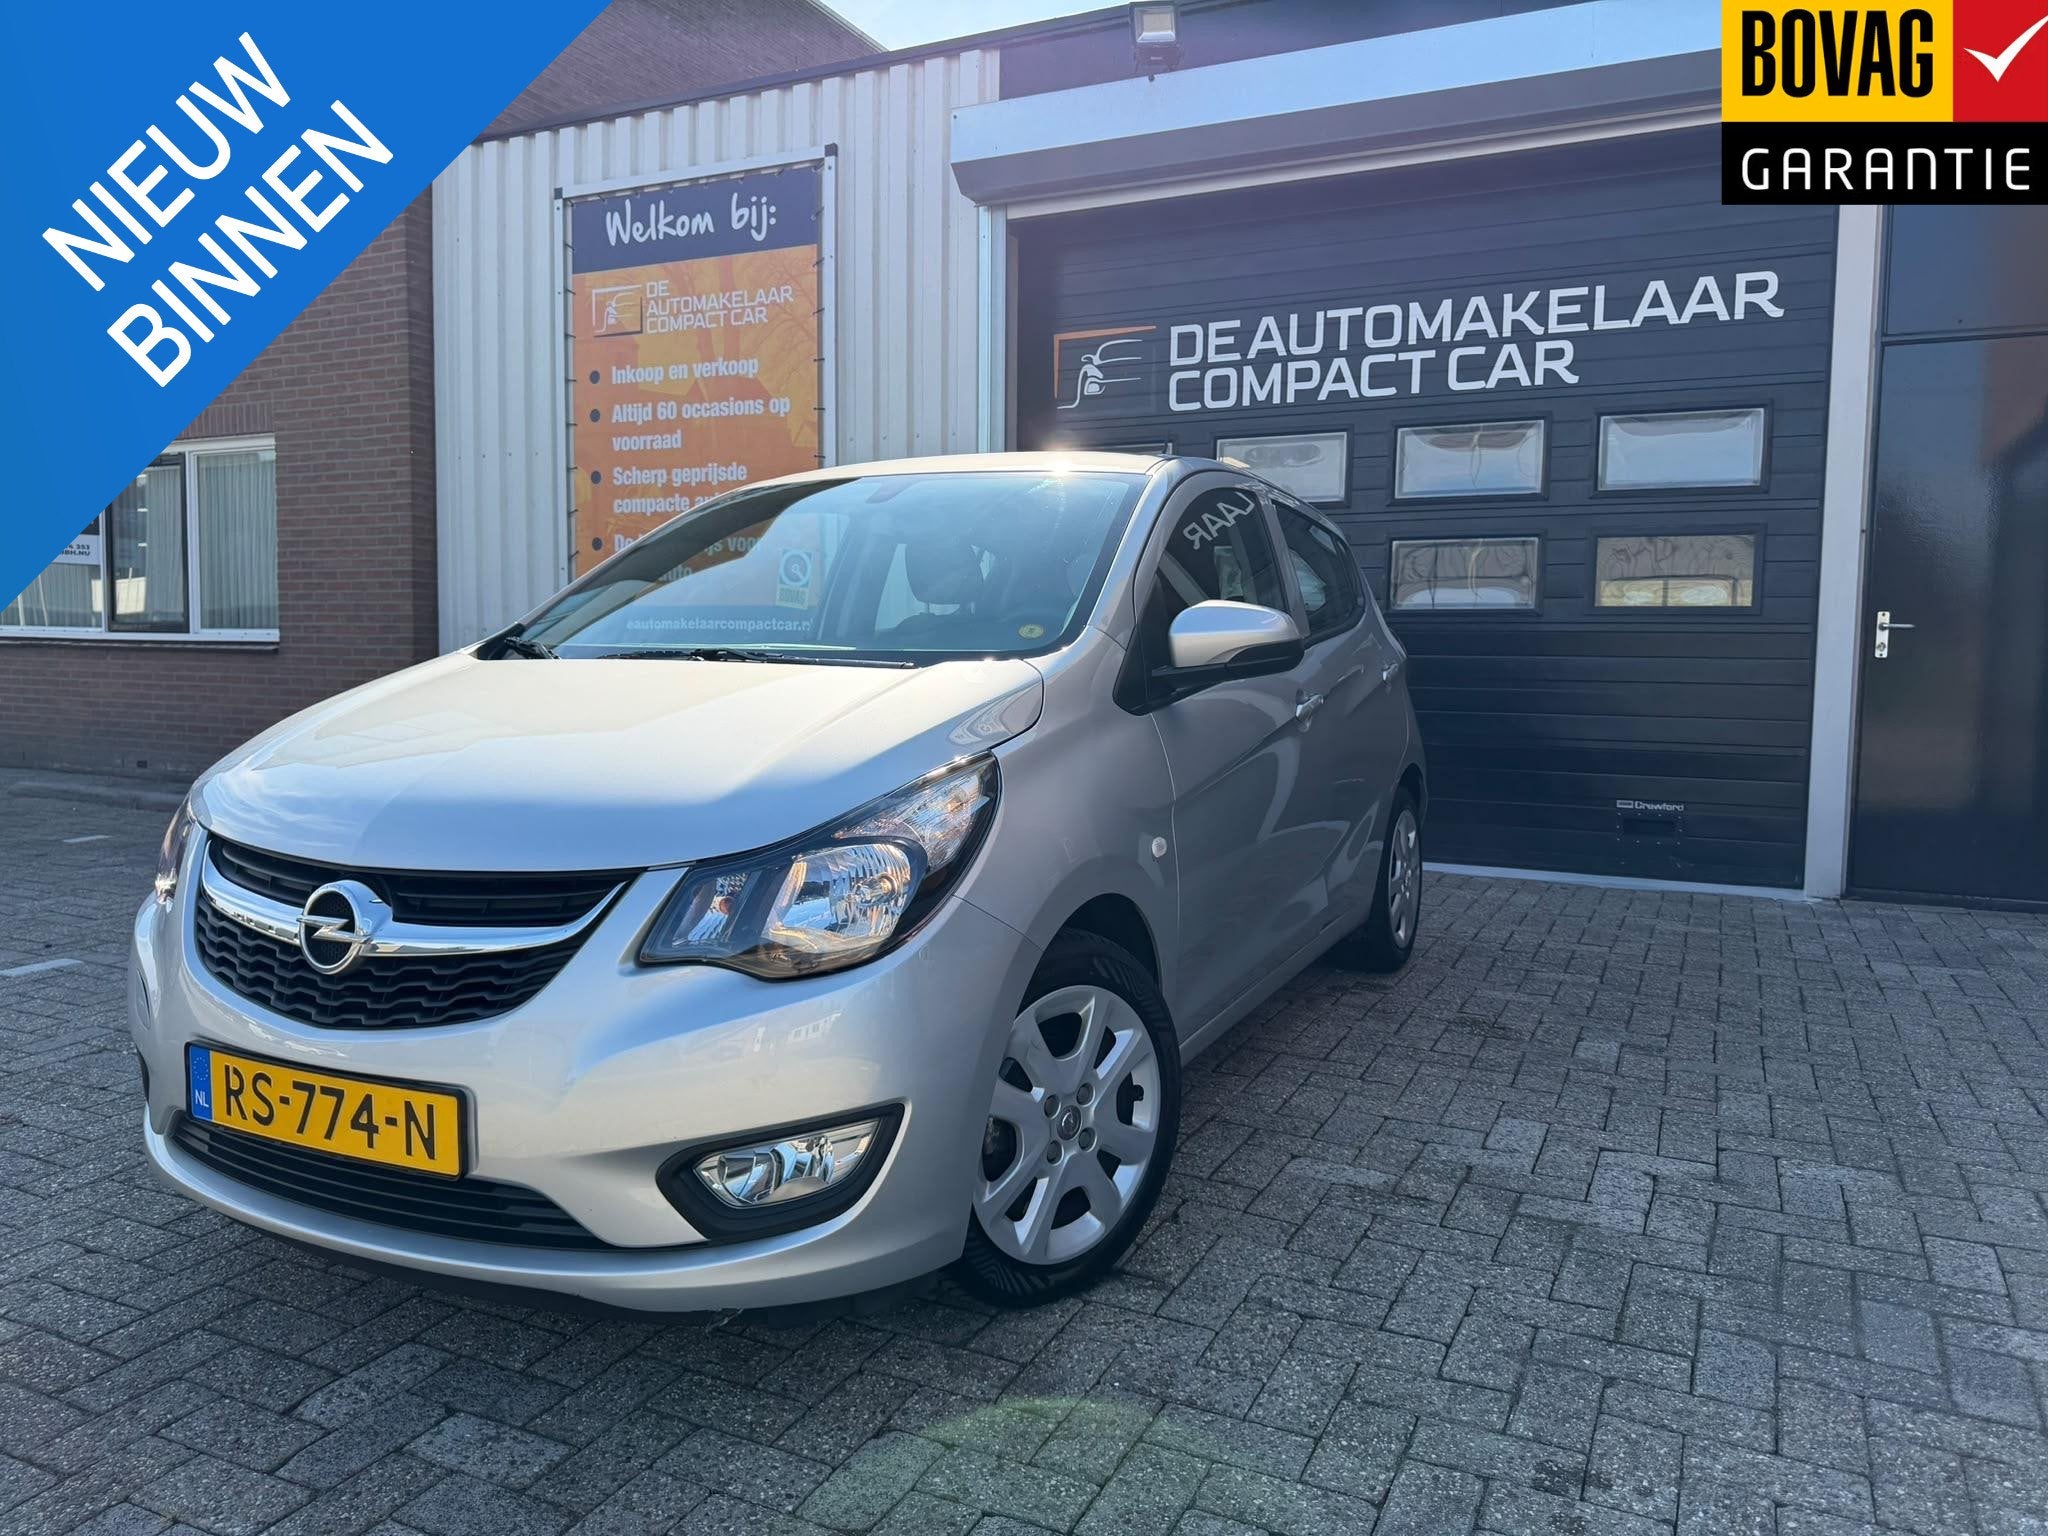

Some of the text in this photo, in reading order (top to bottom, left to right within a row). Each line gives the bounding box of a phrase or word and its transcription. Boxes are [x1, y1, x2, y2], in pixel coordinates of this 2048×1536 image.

[605, 192, 776, 246] Welkom bij:
[646, 280, 670, 298] DE
[646, 285, 794, 317] AUTOMAKELAAR
[646, 307, 768, 334] COMPACT CAR
[1168, 270, 1785, 367] DE AUTOMAKELAAR
[611, 357, 759, 384] Inkoop en verkoop
[1167, 339, 1580, 412] COMPACT CAR
[611, 397, 791, 425] Altijd 60 occasions op
[612, 430, 682, 451] voorraad
[613, 463, 747, 487] Scherp geprijsde
[613, 493, 690, 515] compacte
[1635, 801, 1684, 811] Crawford
[195, 1091, 210, 1108] NL
[224, 1064, 437, 1160] RS-774-N
